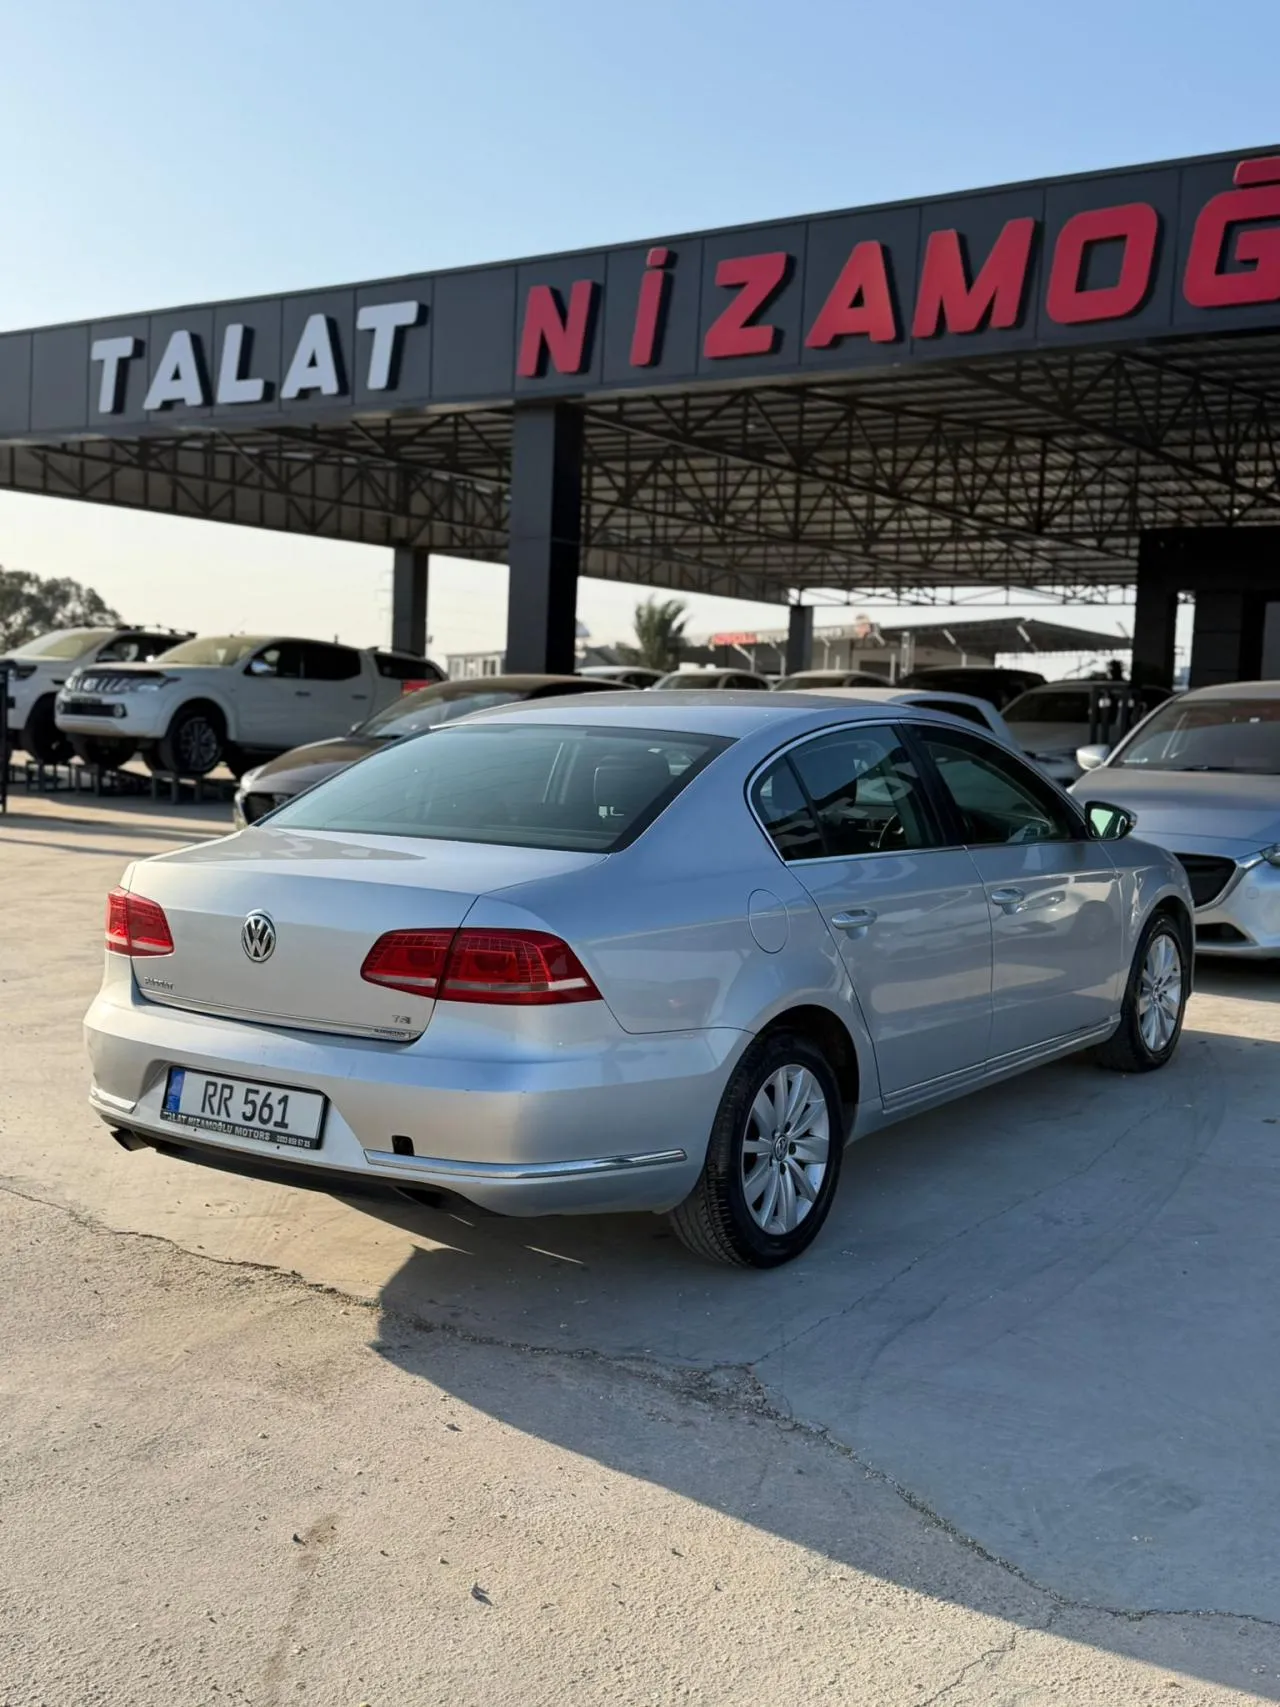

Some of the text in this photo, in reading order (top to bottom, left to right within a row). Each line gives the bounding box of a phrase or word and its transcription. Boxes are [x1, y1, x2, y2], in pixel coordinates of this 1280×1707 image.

[91, 301, 419, 413] TALAT
[201, 1080, 290, 1130] RR 561
[235, 1127, 271, 1141] MOTORS
